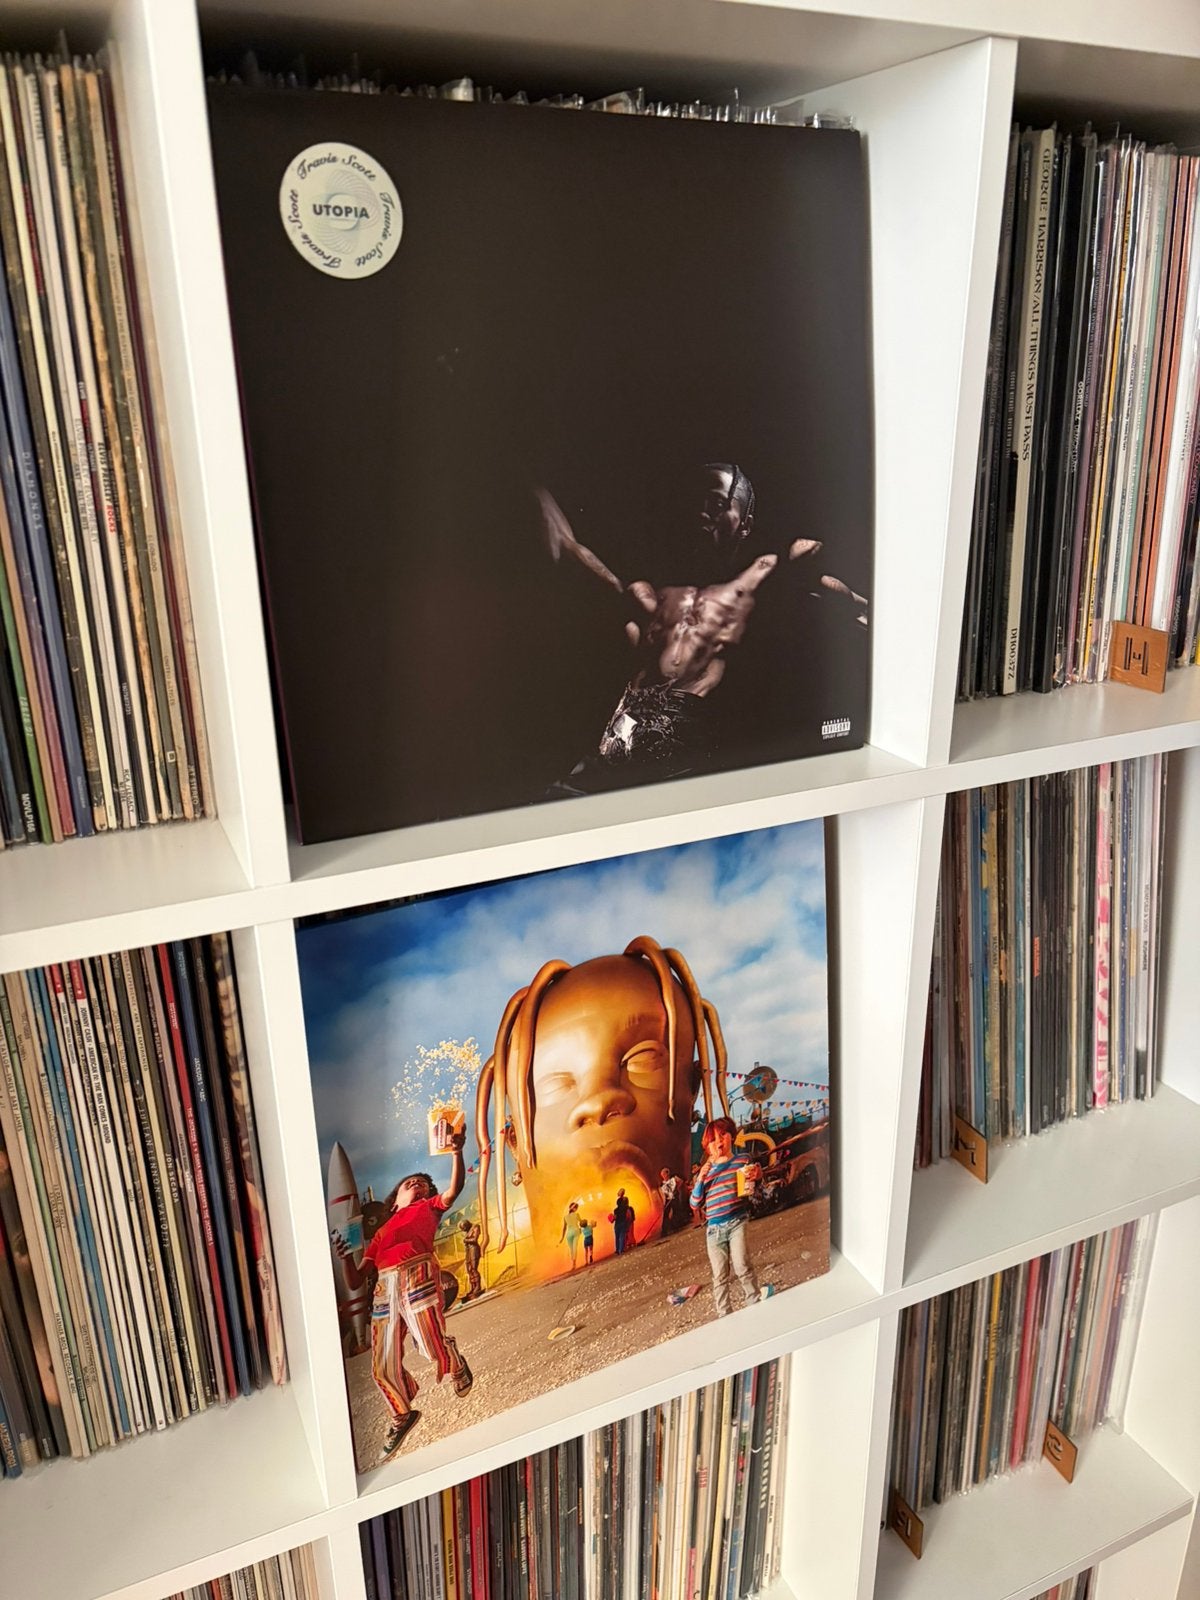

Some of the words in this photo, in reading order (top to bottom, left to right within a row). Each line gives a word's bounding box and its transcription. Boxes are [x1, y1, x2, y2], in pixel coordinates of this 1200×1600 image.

[297, 152, 339, 180] Travis
[342, 154, 377, 182] Scott
[1039, 148, 1051, 210] GEORGE
[313, 203, 370, 219] UTOPIA
[379, 191, 395, 240] Travis
[1027, 327, 1038, 380] THINGS
[1024, 383, 1034, 422] MUST
[1074, 381, 1084, 420] GORILLAZ
[96, 441, 107, 464] ELVIS
[1021, 424, 1031, 461] PASS
[99, 466, 113, 502] PRESLEY
[105, 504, 116, 533] ROCKS
[823, 722, 850, 735] ADVISORY
[80, 1006, 90, 1028] JOHNNY
[83, 1028, 92, 1042] CASH
[86, 1046, 98, 1073] AMERICAN
[193, 1056, 202, 1081] JACKSON
[93, 1082, 101, 1092] THE
[95, 1092, 103, 1104] MAN
[97, 1104, 107, 1122] COMES
[101, 1123, 111, 1143] AROUND
[138, 1107, 152, 1146] JULIAN
[146, 1150, 160, 1193] LENNON
[164, 1152, 173, 1168] JON
[166, 1171, 181, 1203] SECADA
[187, 1118, 197, 1142] JACKSON
[193, 1152, 201, 1168] DIANA
[198, 1183, 208, 1208] PRESENTS
[204, 1219, 213, 1240] JACKSON
[54, 1311, 64, 1335] WARNER
[62, 1353, 72, 1376] RECORDS
